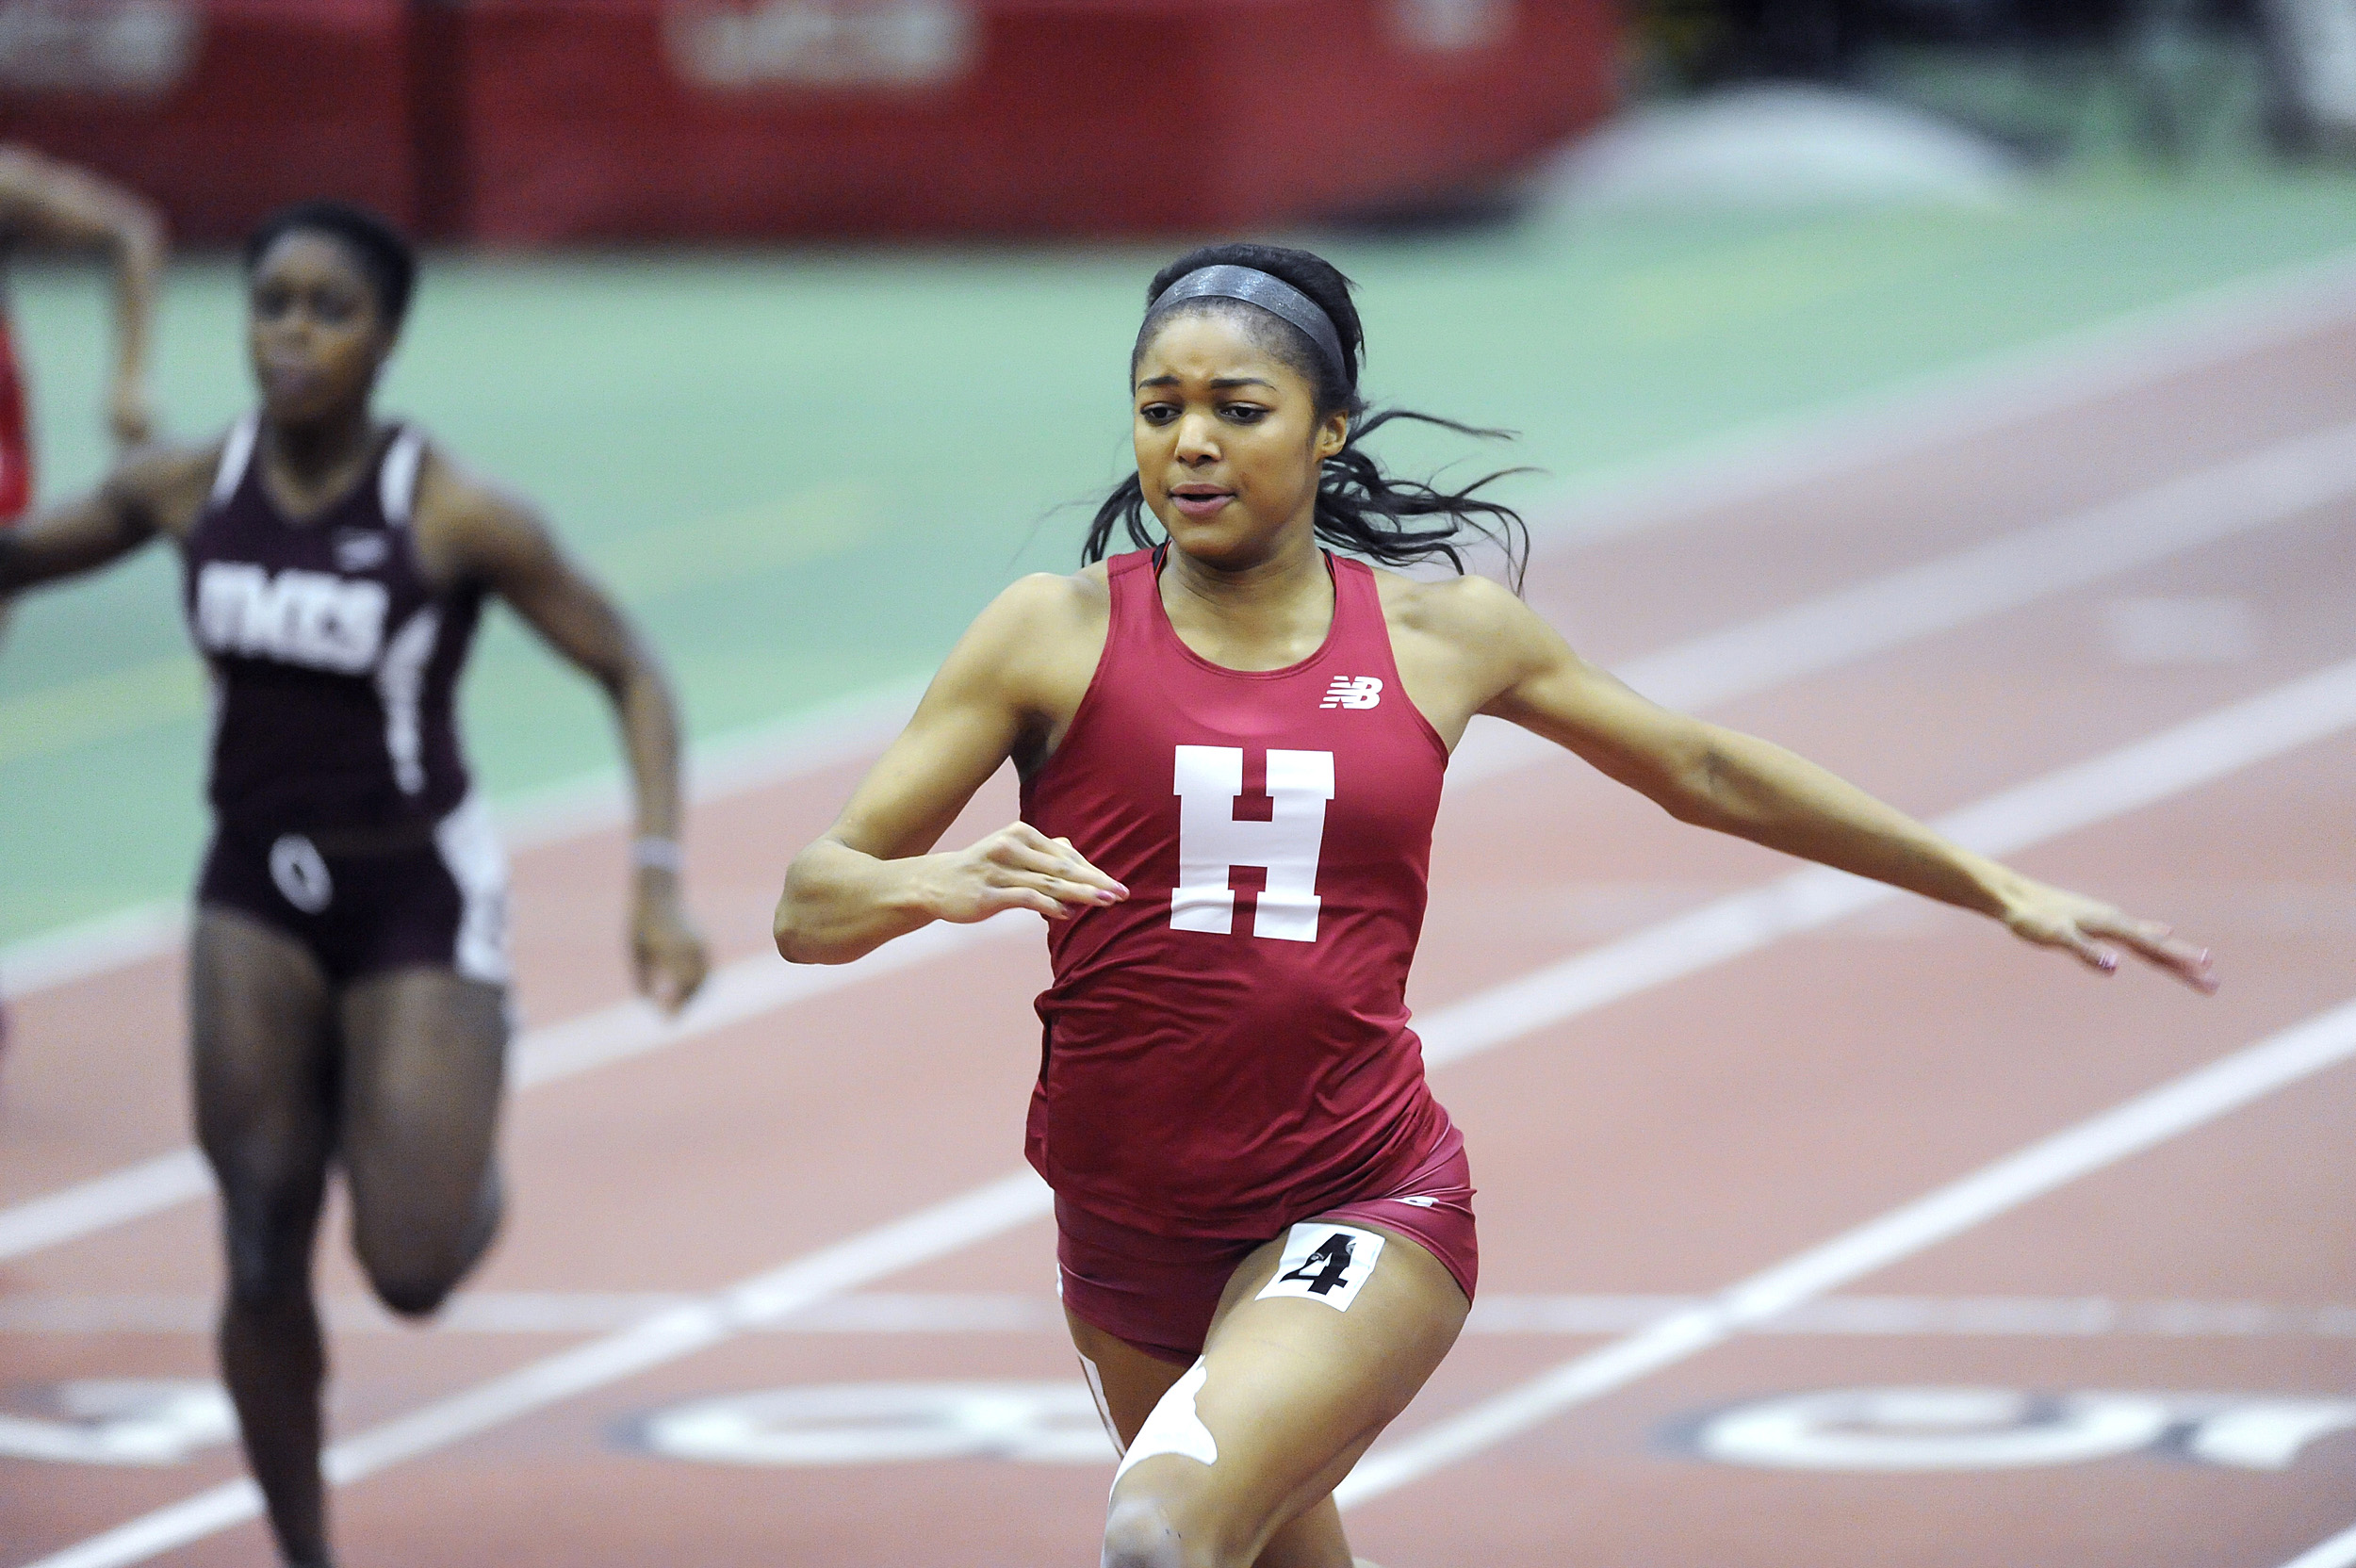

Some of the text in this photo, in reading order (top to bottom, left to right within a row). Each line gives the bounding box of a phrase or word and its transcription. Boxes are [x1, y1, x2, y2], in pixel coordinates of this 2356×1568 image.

[1319, 676, 1383, 710] NB
[1170, 744, 1335, 942] H
[1279, 1233, 1357, 1296] 4
